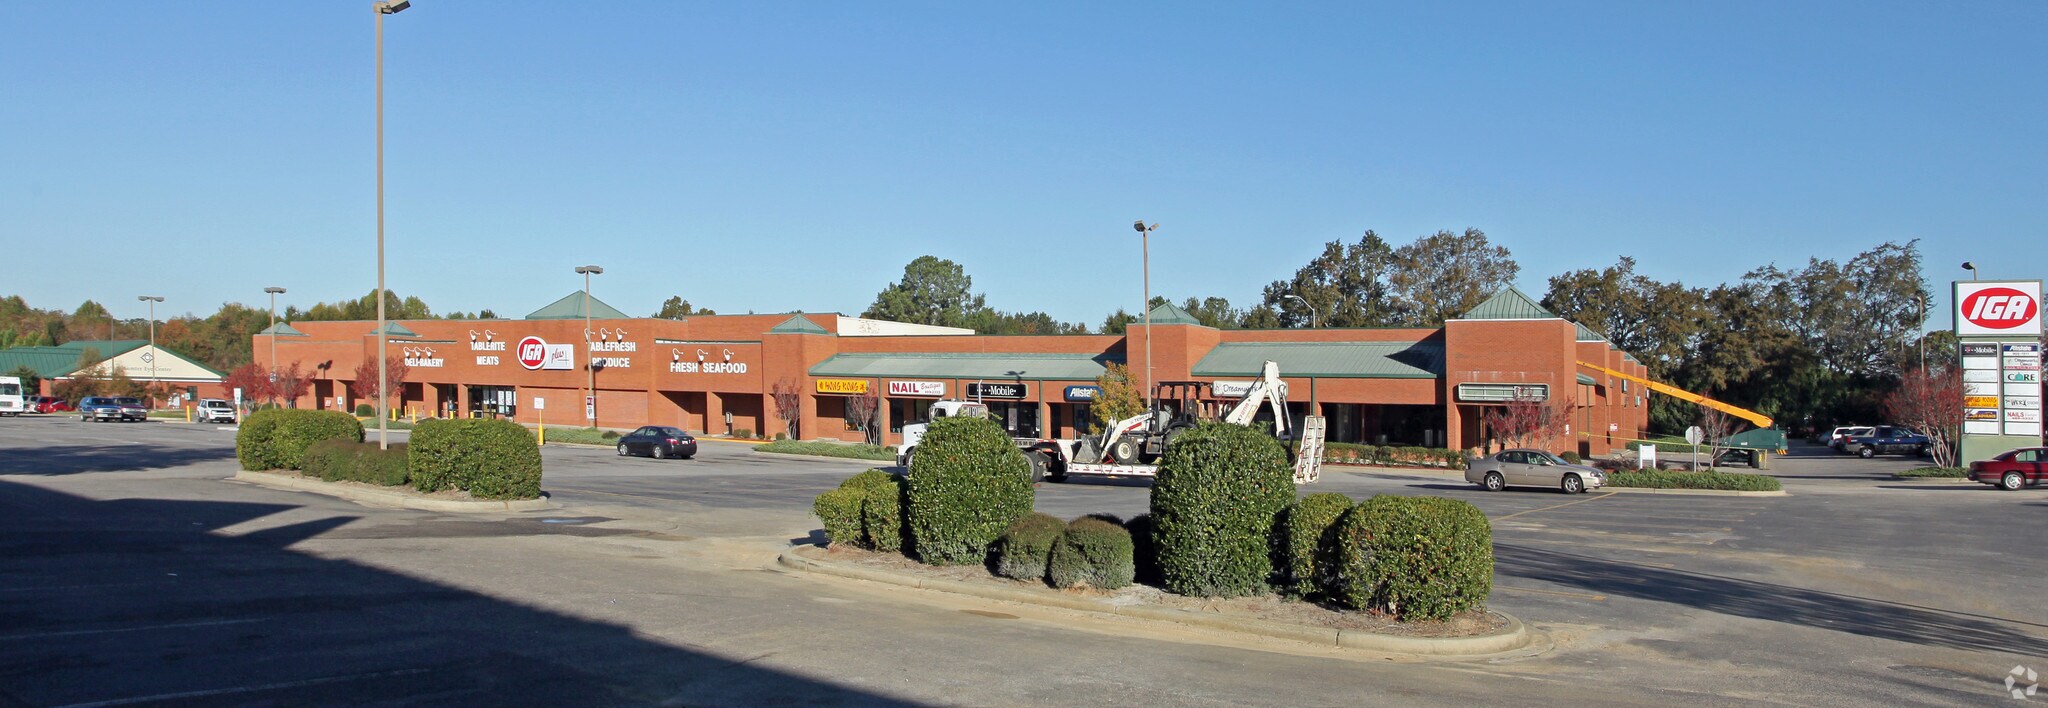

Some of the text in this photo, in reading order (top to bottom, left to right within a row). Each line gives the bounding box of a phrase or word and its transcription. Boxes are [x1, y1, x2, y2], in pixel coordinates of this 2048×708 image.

[1969, 295, 2030, 320] IGA
[471, 342, 505, 351] TABLERITE
[587, 341, 636, 352] ABLEFRESH
[521, 343, 543, 361] IGA
[476, 356, 499, 365] MEATS
[592, 357, 631, 368] PRODUCE
[670, 362, 747, 374] FRESH SEAFOOD
[2007, 373, 2036, 381] CRE
[892, 383, 919, 393] NAIL
[1070, 387, 1096, 397] Allstat
